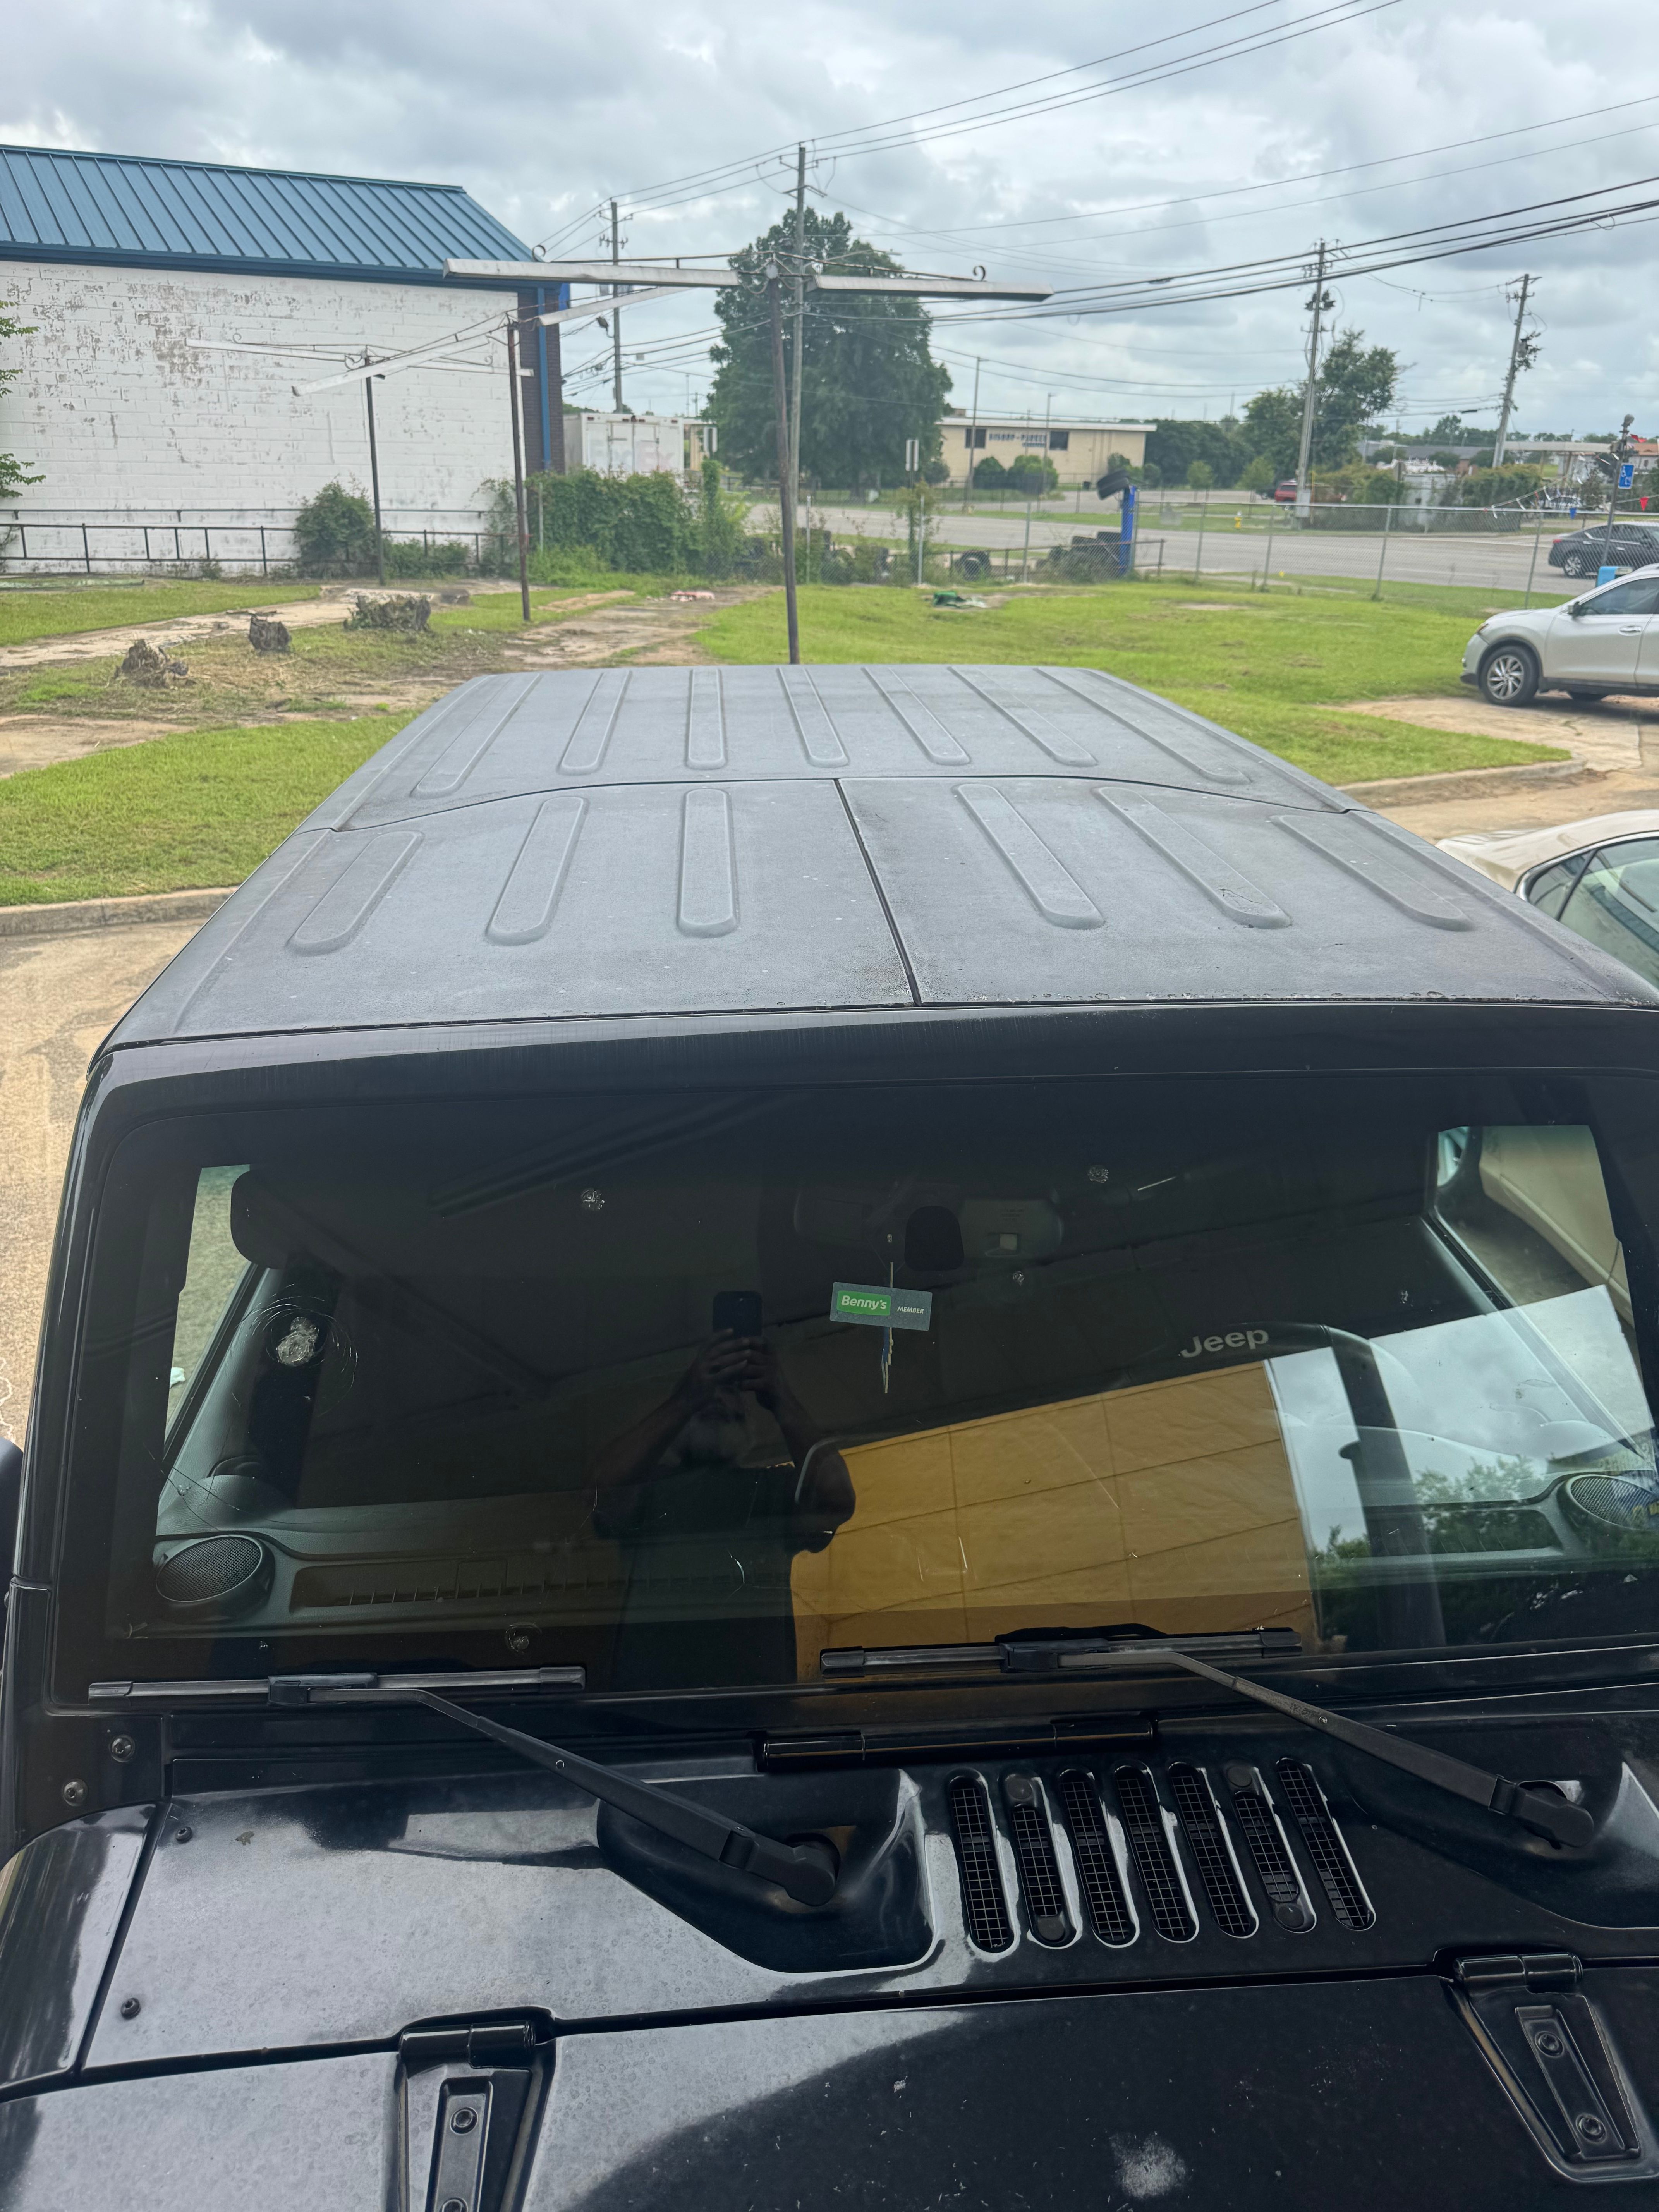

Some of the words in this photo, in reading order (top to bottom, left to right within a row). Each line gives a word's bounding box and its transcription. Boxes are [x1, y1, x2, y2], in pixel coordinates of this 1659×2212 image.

[841, 1295, 887, 1310] Benny's
[897, 1306, 924, 1314] MEMBER
[1180, 1329, 1269, 1358] Jeep
